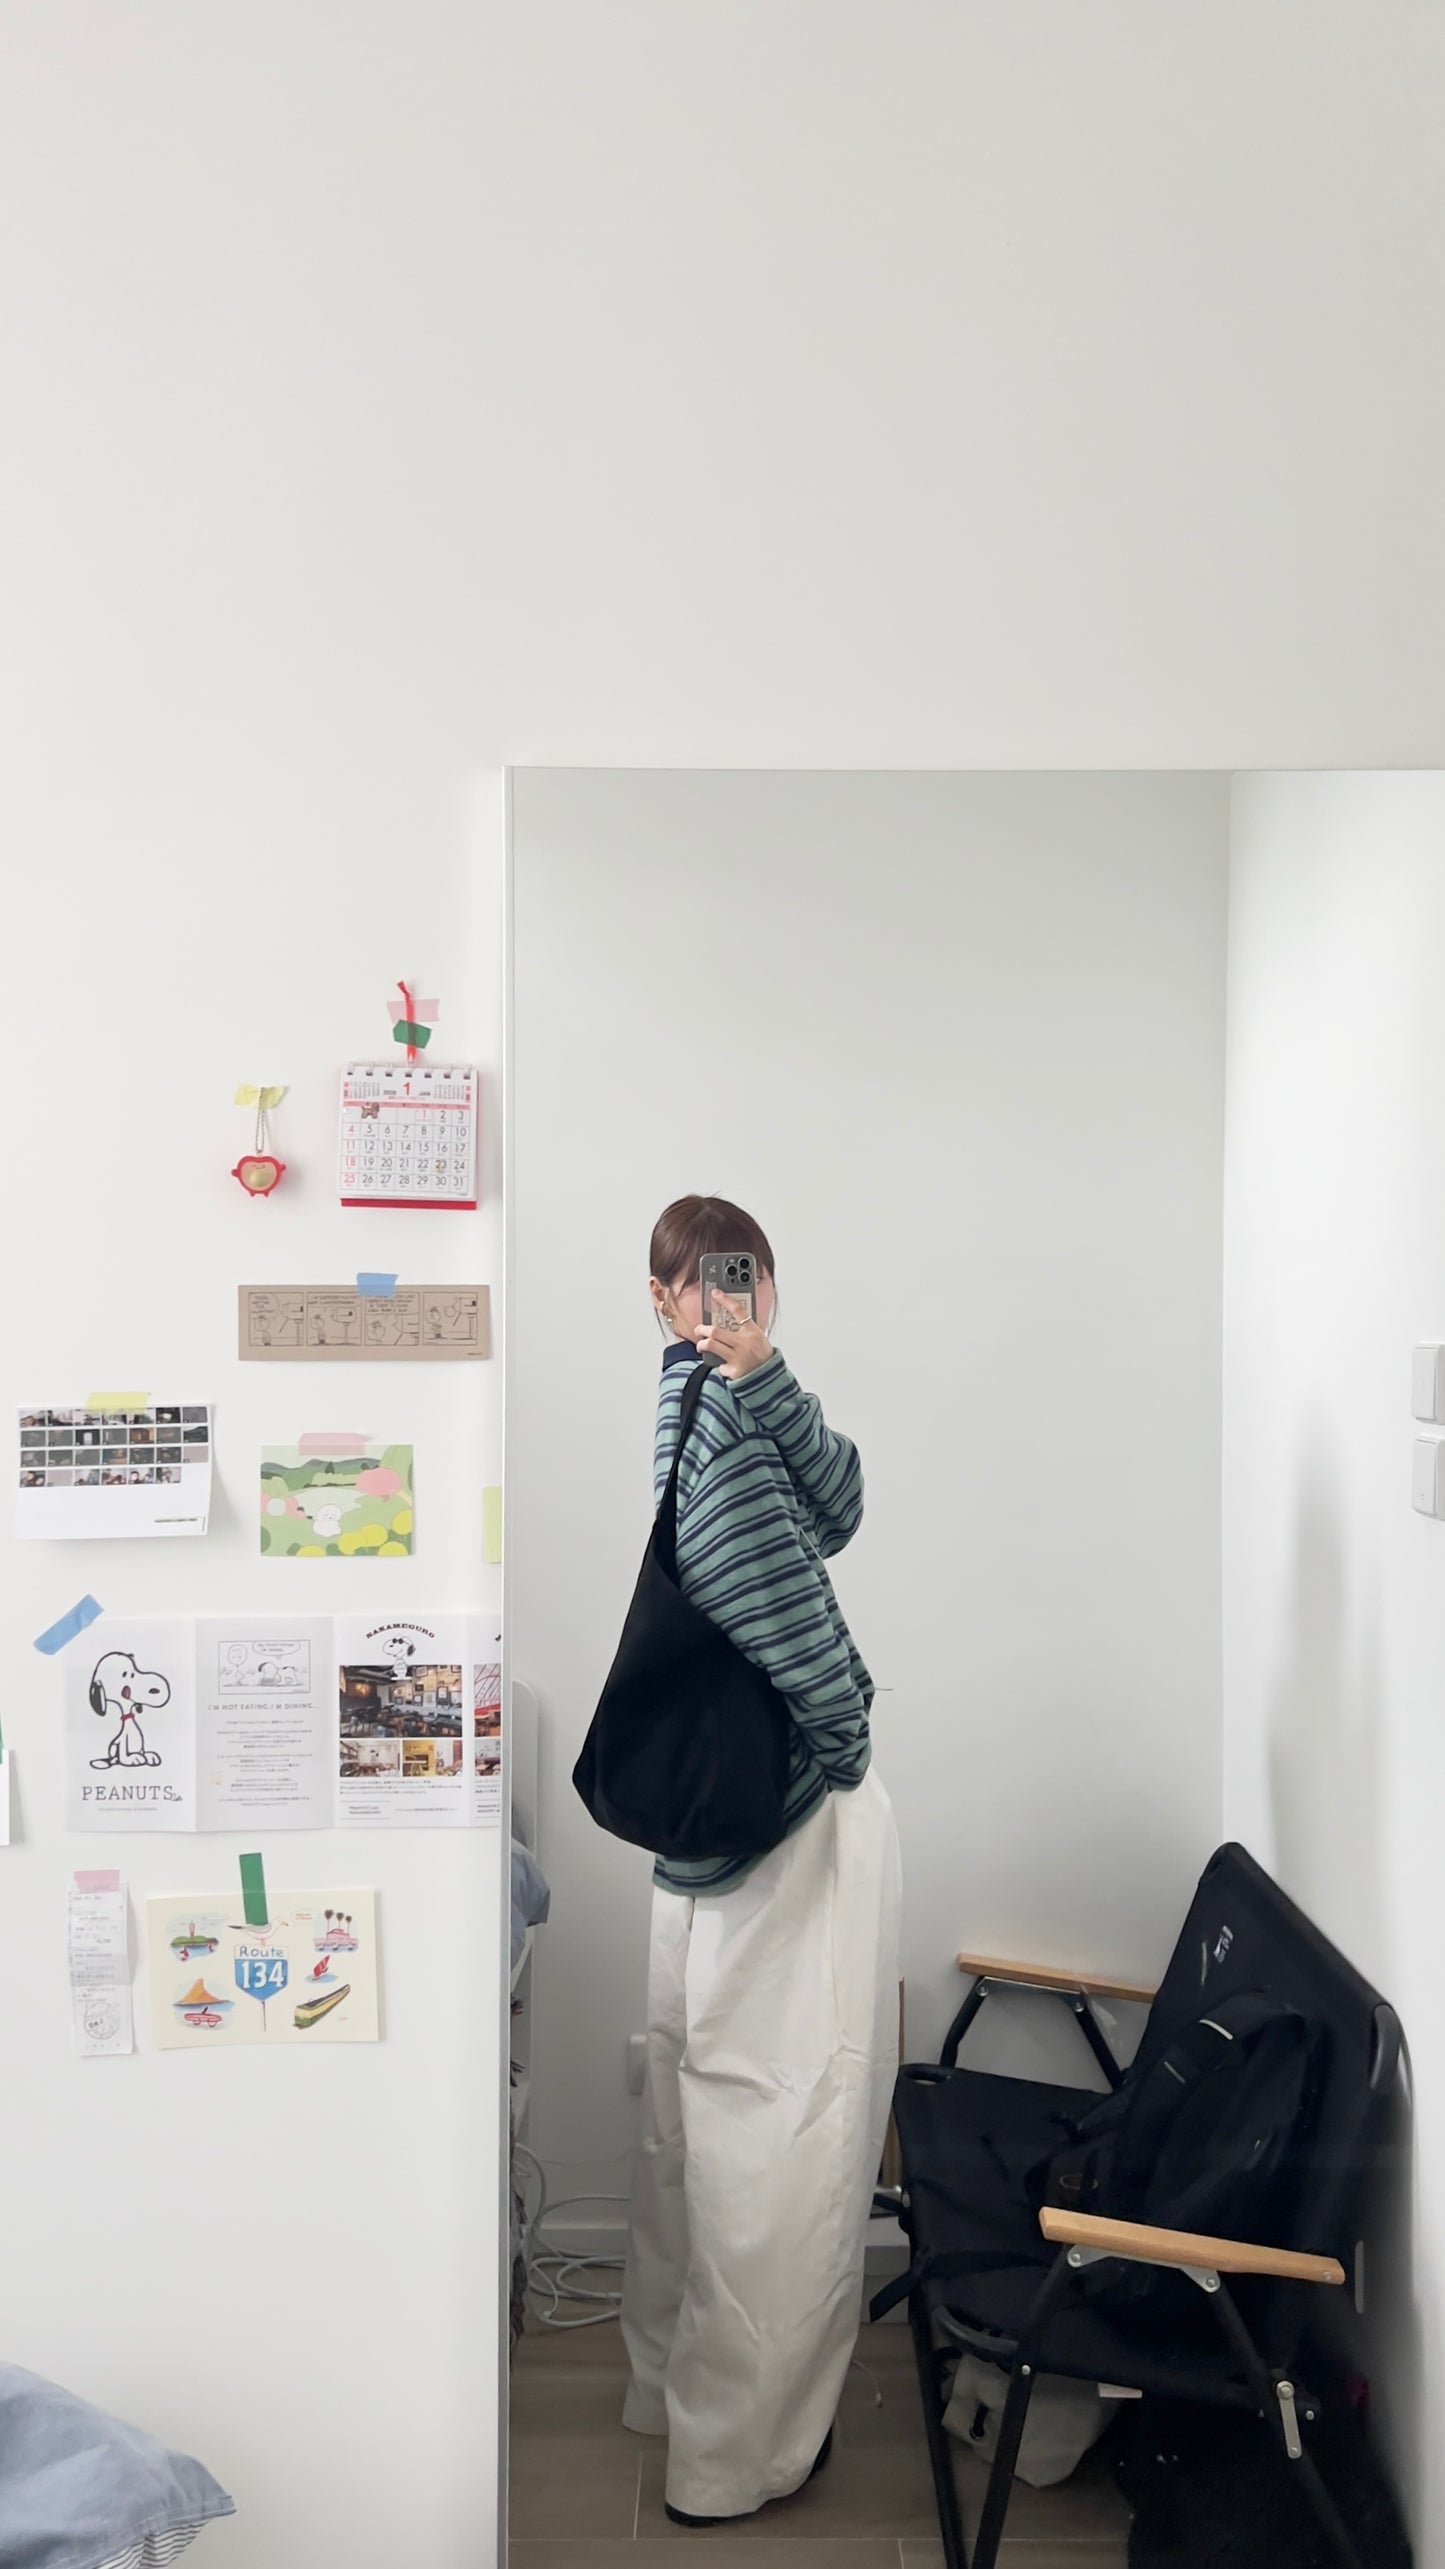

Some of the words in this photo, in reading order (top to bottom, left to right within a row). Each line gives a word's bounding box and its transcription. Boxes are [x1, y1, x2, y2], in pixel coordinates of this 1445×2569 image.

[403, 1082, 410, 1096] 1
[440, 1110, 446, 1119] 2
[458, 1111, 464, 1120] 3
[348, 1125, 355, 1133] 4
[366, 1125, 372, 1133] 5
[385, 1125, 391, 1134] 6
[421, 1126, 427, 1135] 8
[439, 1127, 445, 1135] 9
[456, 1127, 467, 1137] 10
[346, 1141, 355, 1150] 11
[364, 1141, 375, 1150] 12
[382, 1141, 393, 1151] 13
[400, 1142, 411, 1151] 14
[418, 1142, 429, 1151] 15
[437, 1143, 448, 1152] 16
[455, 1143, 466, 1152] 17
[346, 1157, 356, 1166] 18
[364, 1157, 374, 1166] 19
[381, 1158, 393, 1167] 20
[399, 1159, 409, 1168] 21
[417, 1159, 429, 1168] 22
[435, 1160, 447, 1169] 23
[453, 1160, 465, 1170] 24
[344, 1174, 356, 1183] 25
[362, 1174, 373, 1184] 26
[380, 1175, 392, 1184] 27
[398, 1175, 410, 1184] 28
[417, 1176, 428, 1185] 29
[435, 1176, 446, 1186] 30
[453, 1177, 463, 1186] 31
[82, 1785, 173, 1801] PEANUTS
[239, 1945, 284, 1958] Route
[241, 1961, 285, 1989] 134
